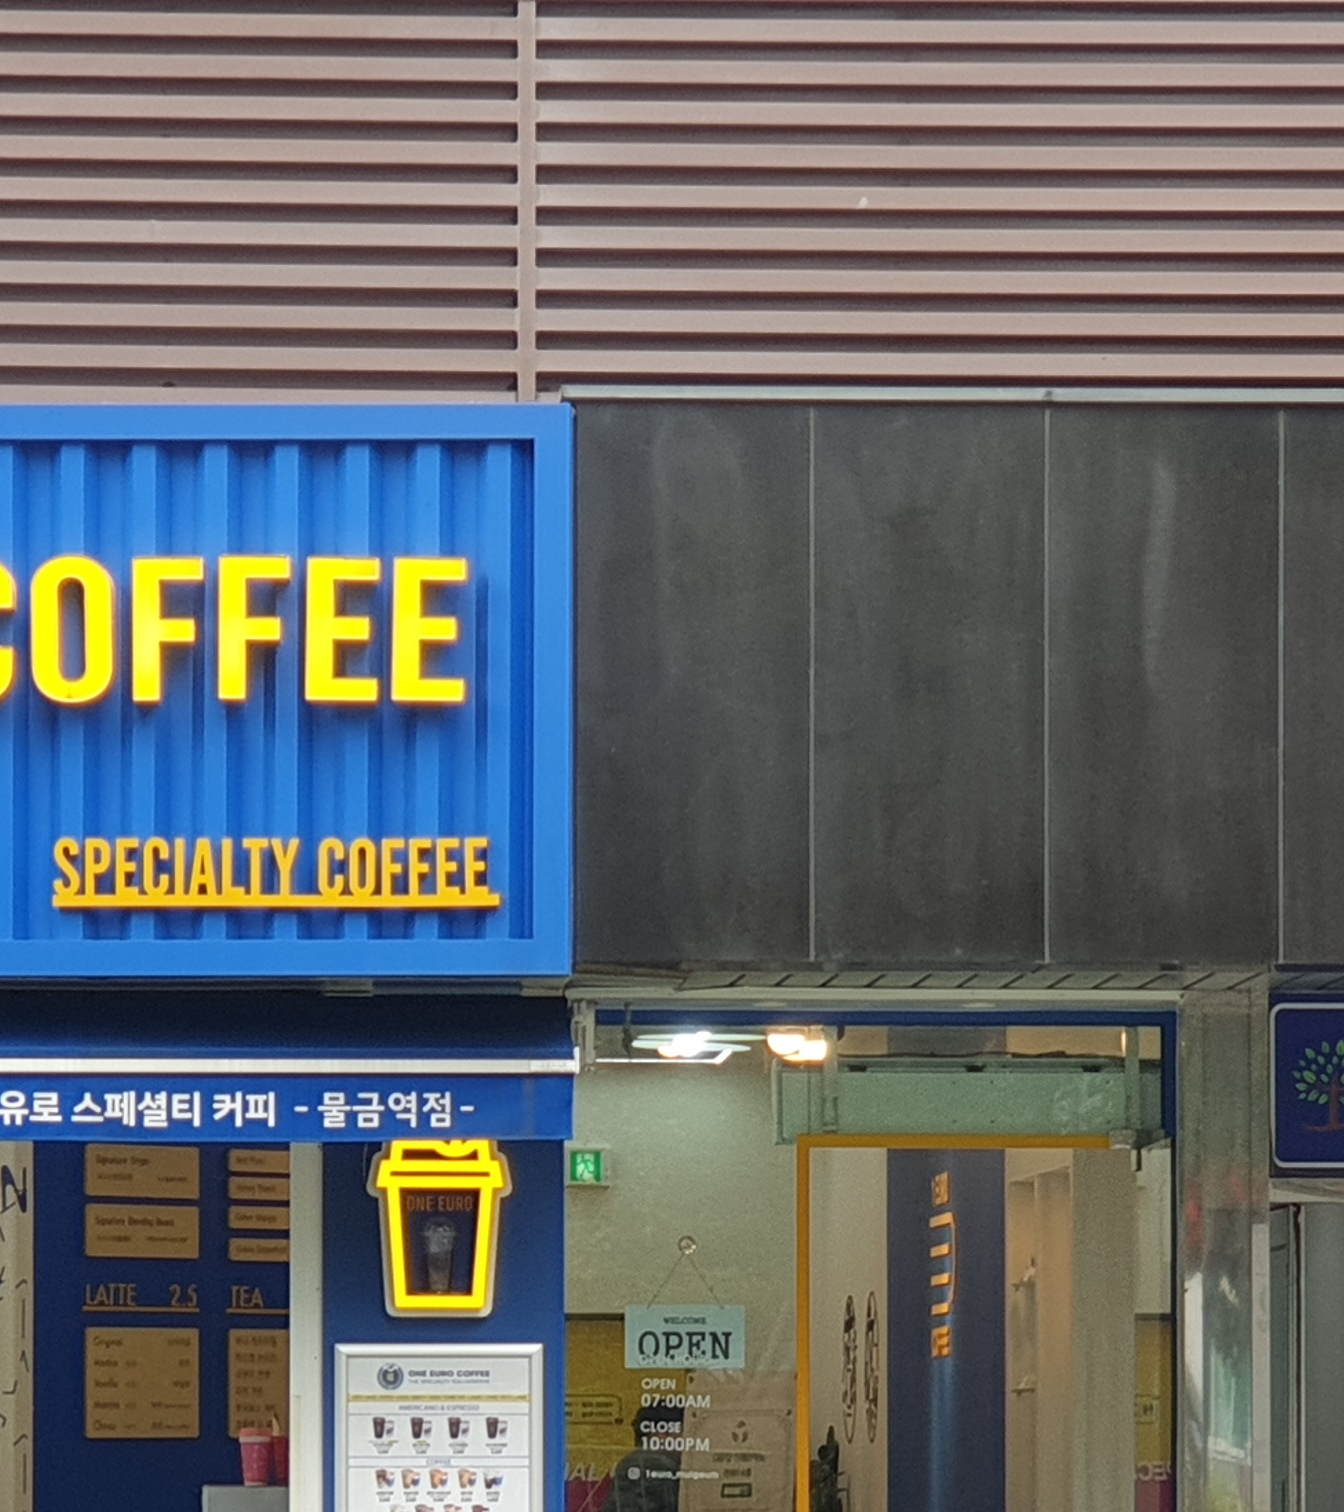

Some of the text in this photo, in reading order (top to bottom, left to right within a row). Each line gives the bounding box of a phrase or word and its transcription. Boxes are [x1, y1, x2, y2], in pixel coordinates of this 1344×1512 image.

[53, 836, 490, 898] SPECIALTY COFFEE
[70, 1089, 202, 1129] 스페셜티
[212, 1091, 276, 1128] 커피
[406, 1194, 475, 1213] ONE EURO
[85, 1283, 199, 1307] LATTE 2.5
[231, 1286, 264, 1308] TEA
[638, 1330, 733, 1361] OPEN
[641, 1378, 676, 1390] OPEN
[640, 1393, 711, 1409] 07:00AM
[640, 1420, 682, 1433] CLOSE
[640, 1436, 710, 1452] 10:00PM
